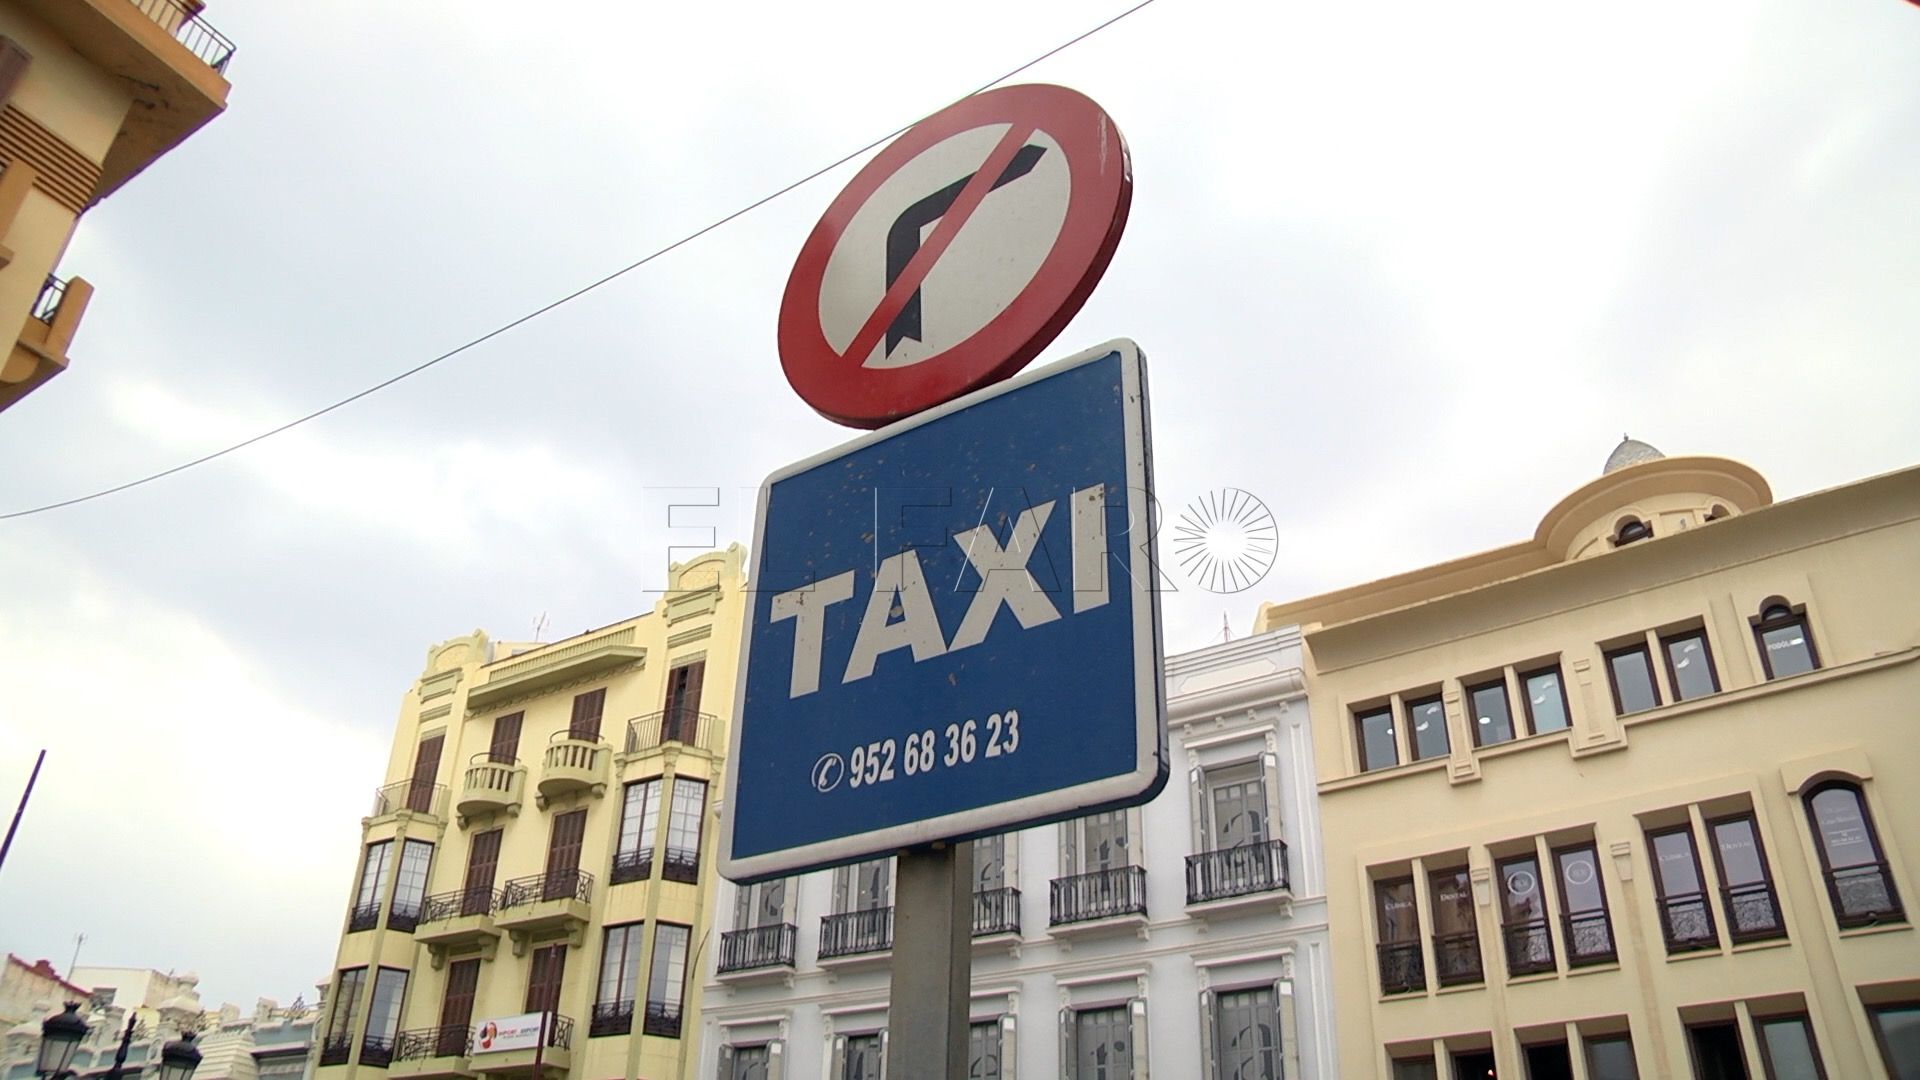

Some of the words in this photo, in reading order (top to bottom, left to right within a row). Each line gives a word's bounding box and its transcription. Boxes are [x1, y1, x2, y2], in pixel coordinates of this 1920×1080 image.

[770, 483, 1110, 698] TAXI
[849, 739, 896, 788] 952
[904, 729, 935, 776] 68
[944, 719, 977, 767] 36
[985, 709, 1019, 758] 23
